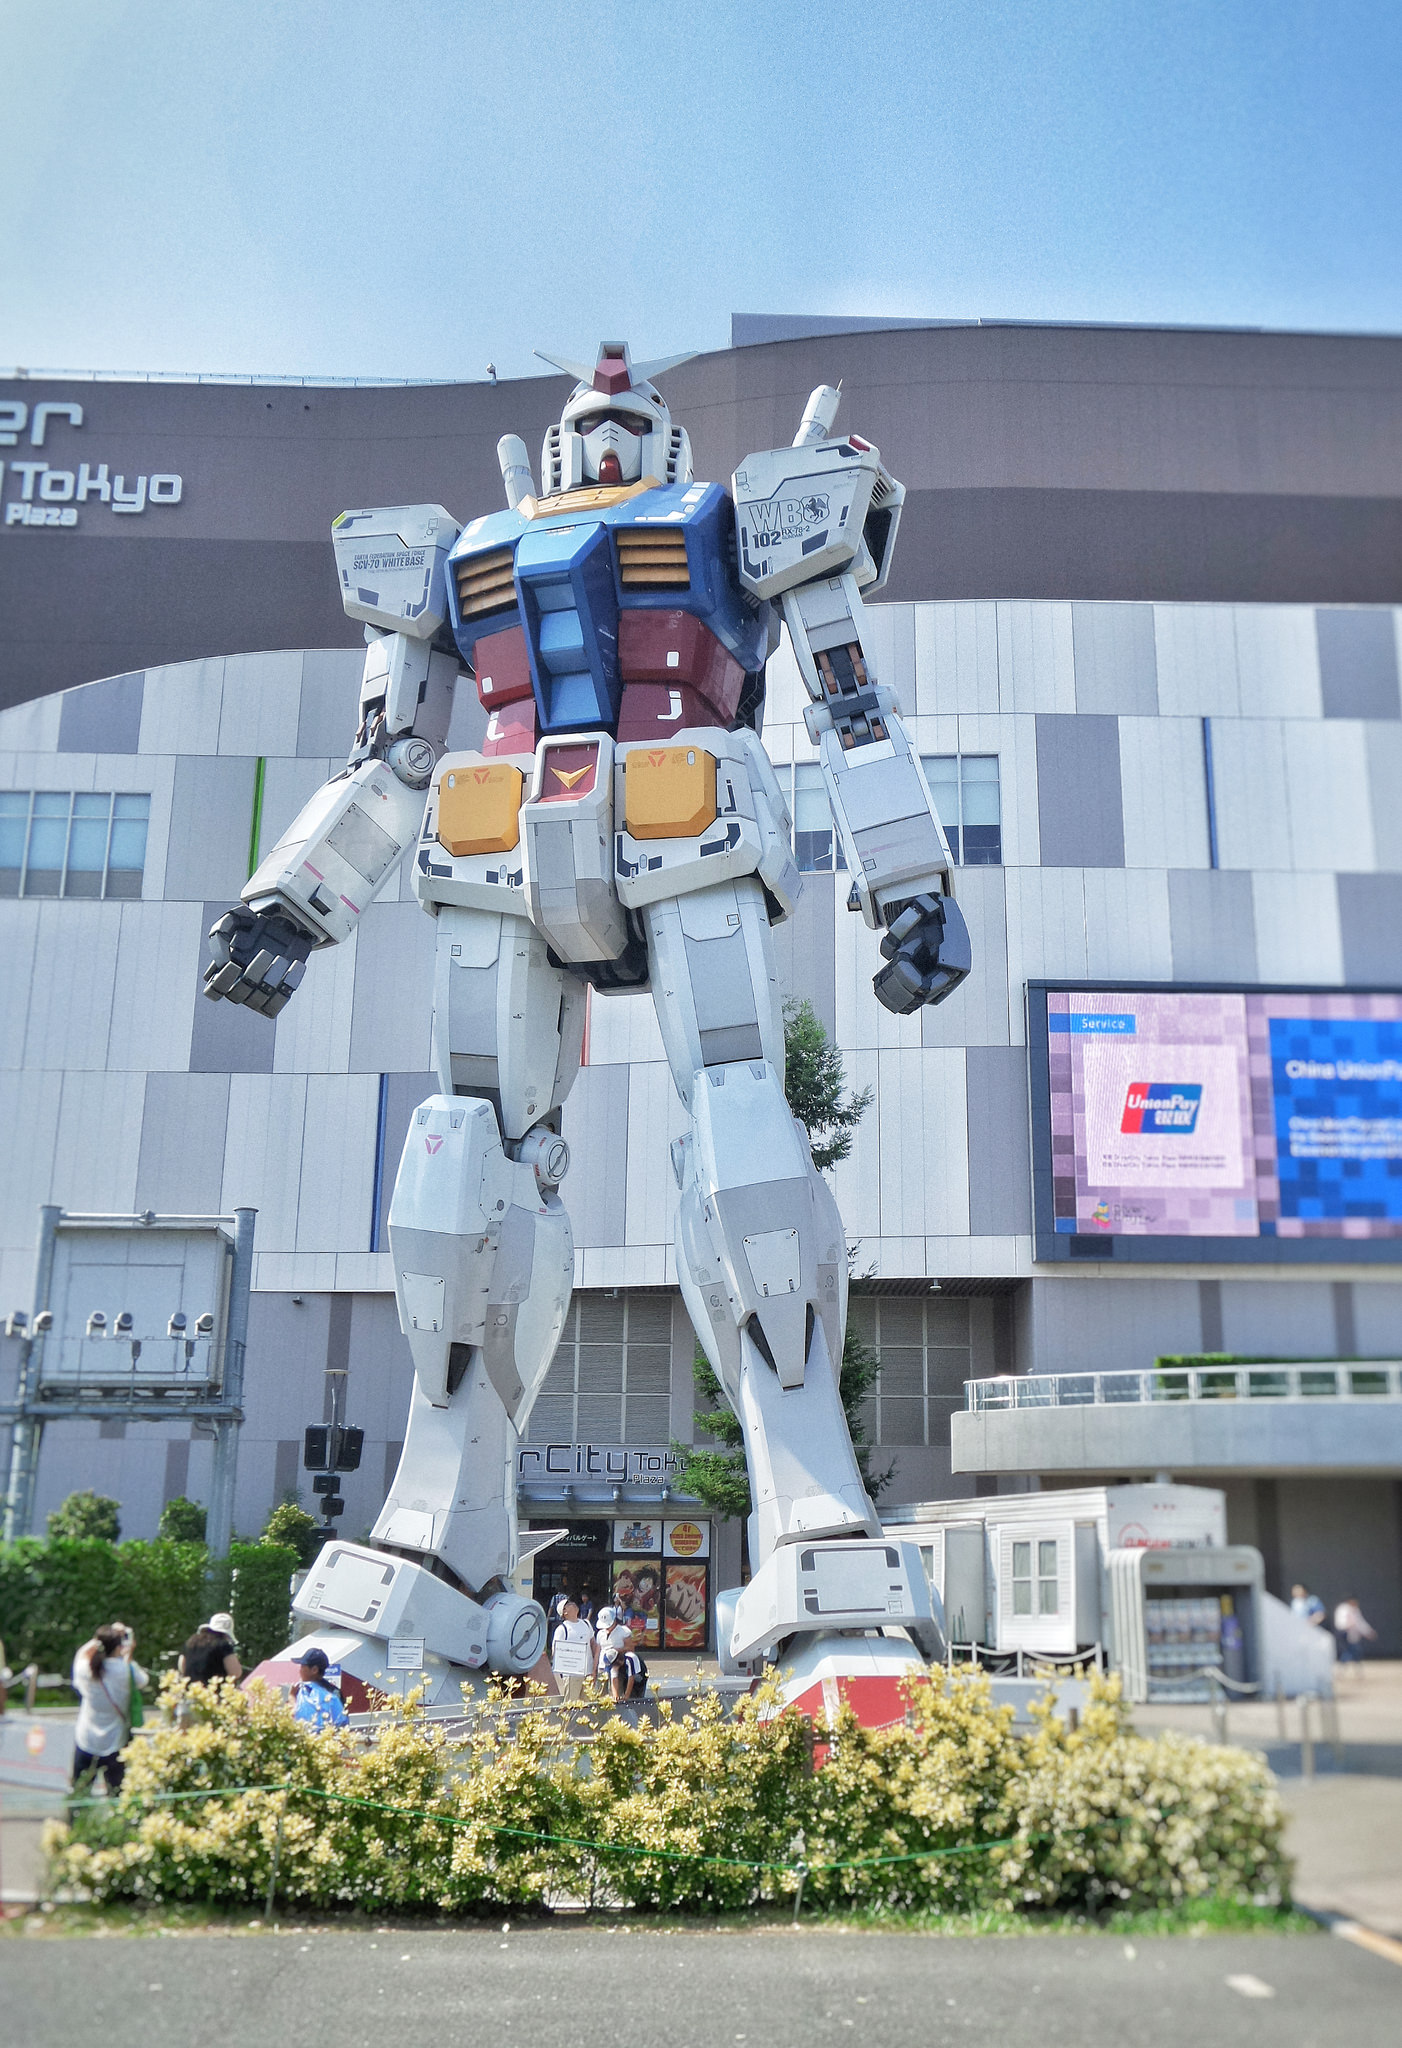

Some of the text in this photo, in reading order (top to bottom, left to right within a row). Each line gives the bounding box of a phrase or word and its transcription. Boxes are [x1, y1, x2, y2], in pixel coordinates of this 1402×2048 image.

[5, 502, 78, 527] Plaza
[748, 499, 803, 533] WB
[752, 530, 782, 549] 102
[781, 525, 810, 536] RX-78-2
[353, 559, 380, 570] SCV-70
[1081, 1018, 1126, 1030] Service
[1285, 1059, 1337, 1080] China
[1127, 1094, 1199, 1119] UnionPay
[632, 1474, 664, 1484] Plaza
